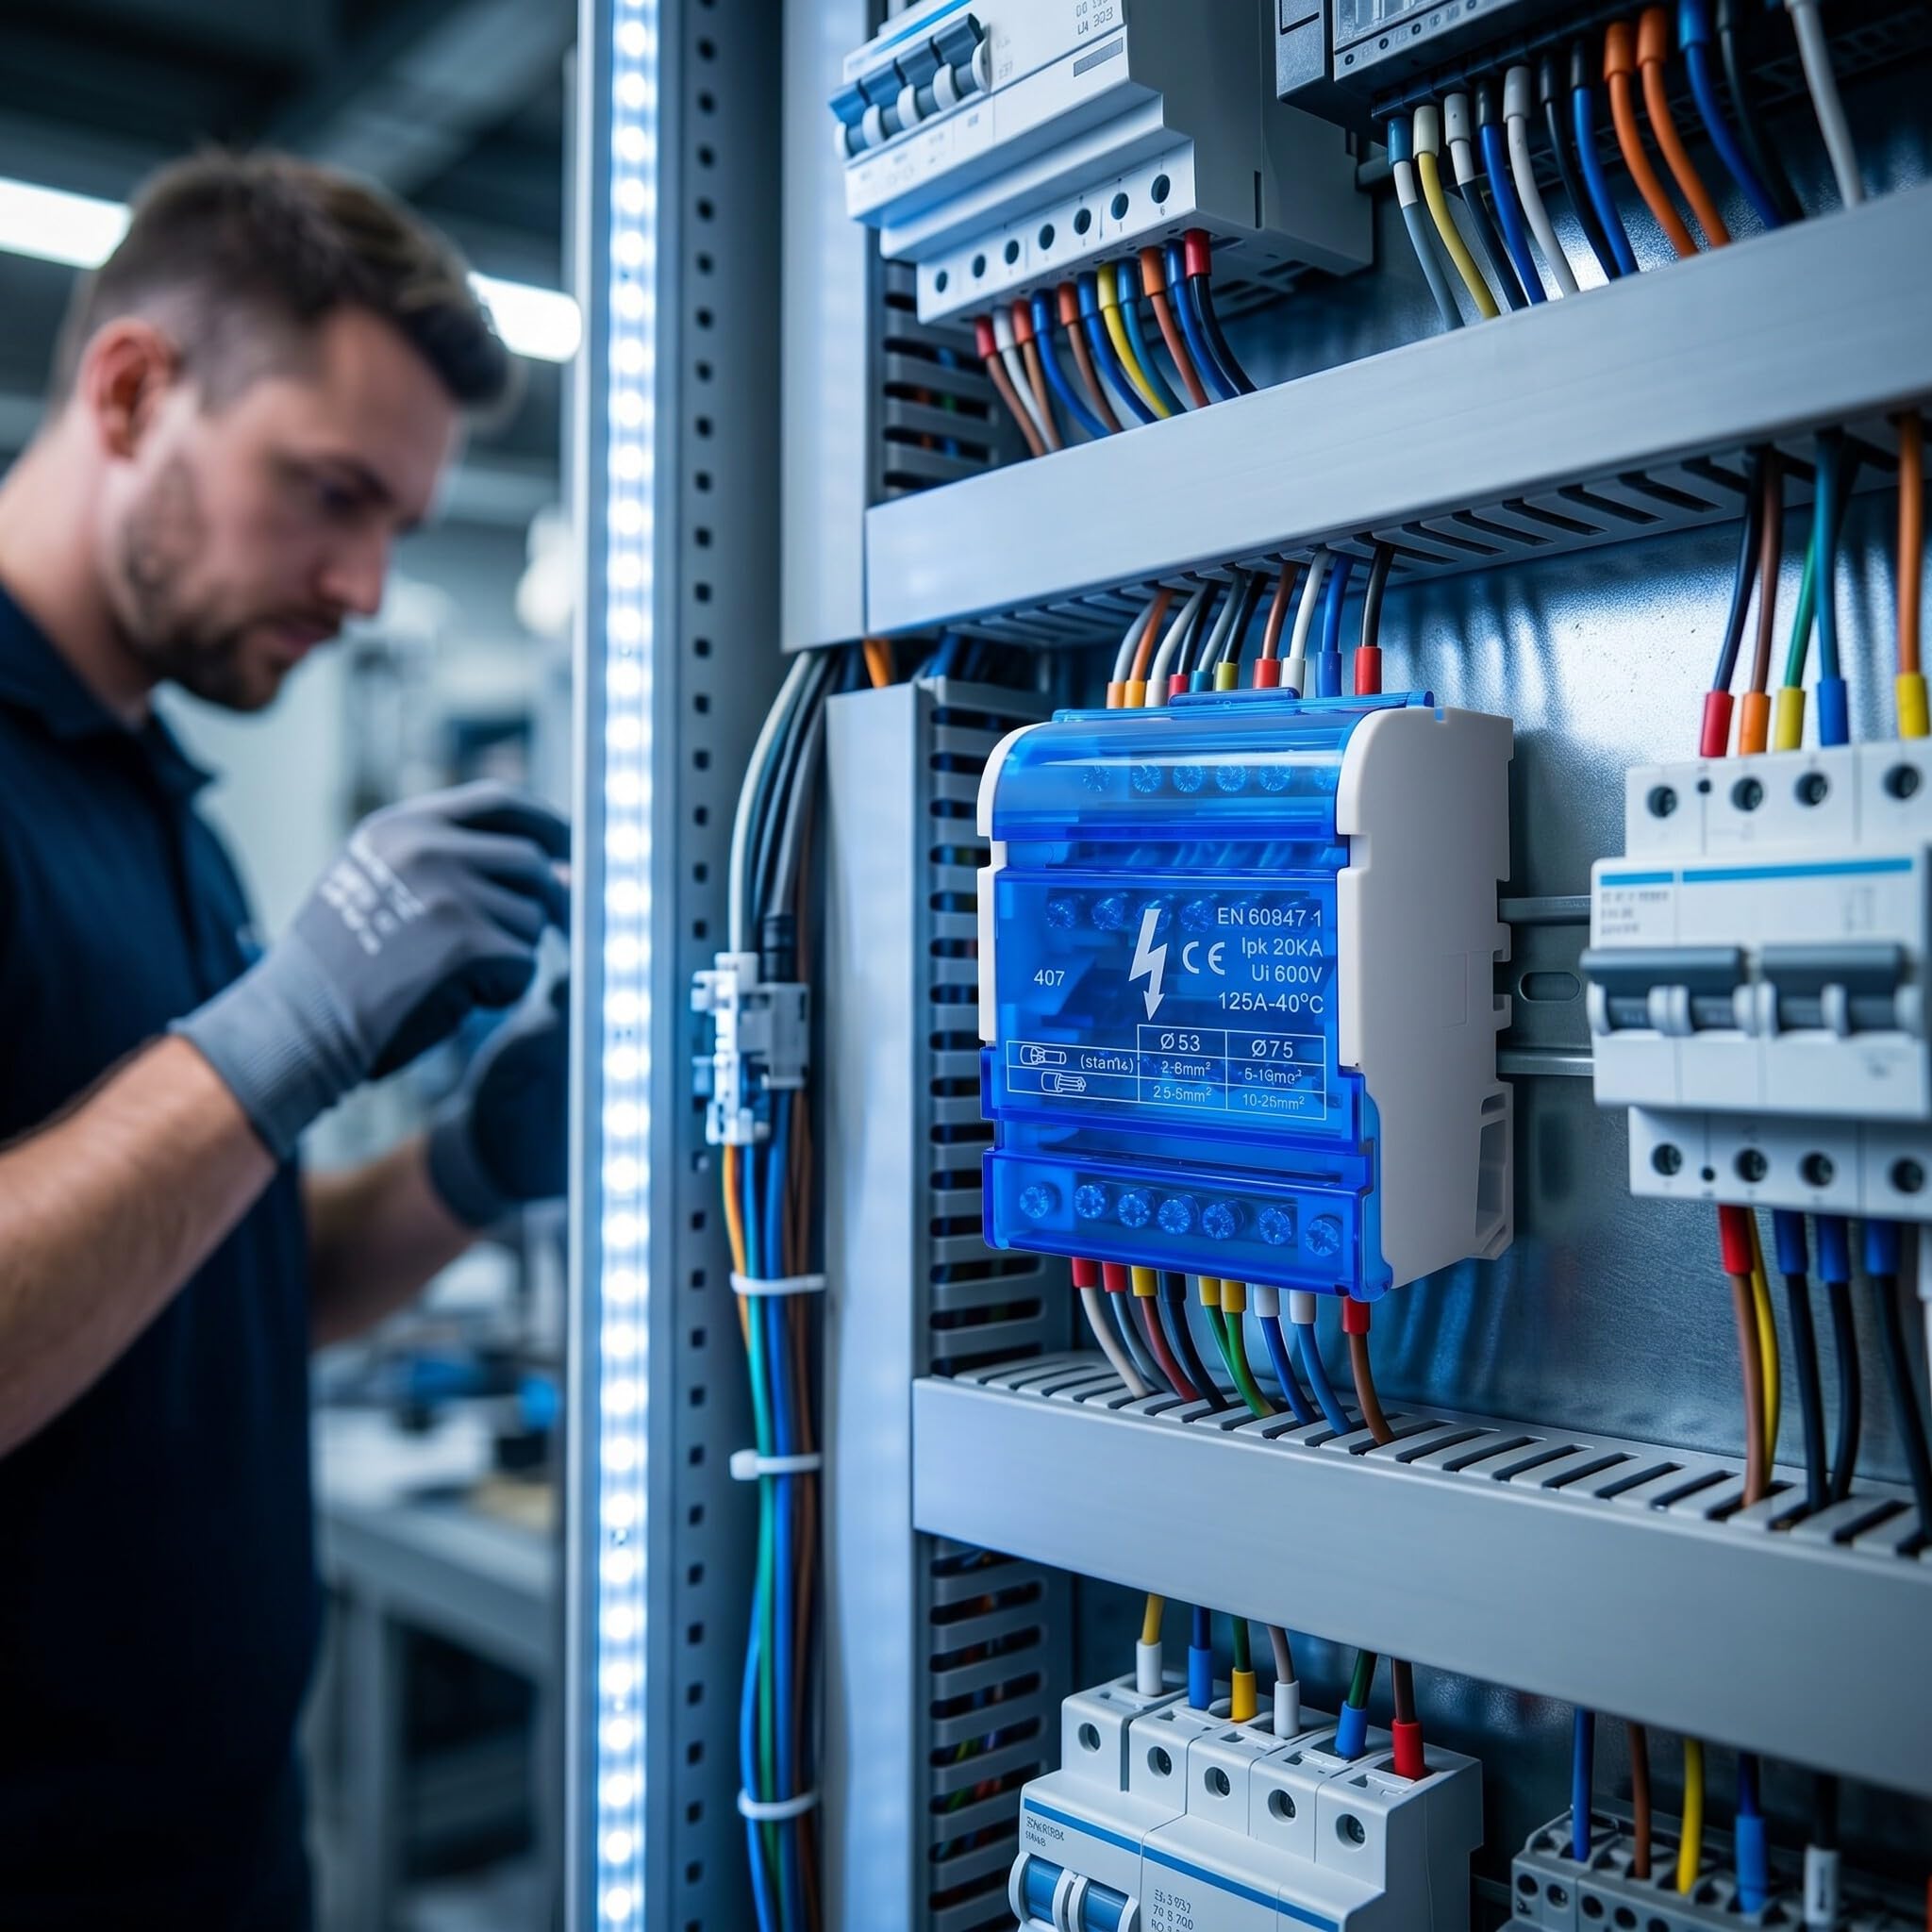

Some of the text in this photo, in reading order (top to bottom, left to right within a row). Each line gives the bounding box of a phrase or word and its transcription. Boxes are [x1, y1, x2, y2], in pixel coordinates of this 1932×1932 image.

[1218, 908, 1243, 925] EN
[1182, 941, 1225, 975] CE
[1273, 938, 1323, 958] 20KA
[1033, 969, 1065, 987] 407
[1252, 964, 1323, 984] Ui 600V
